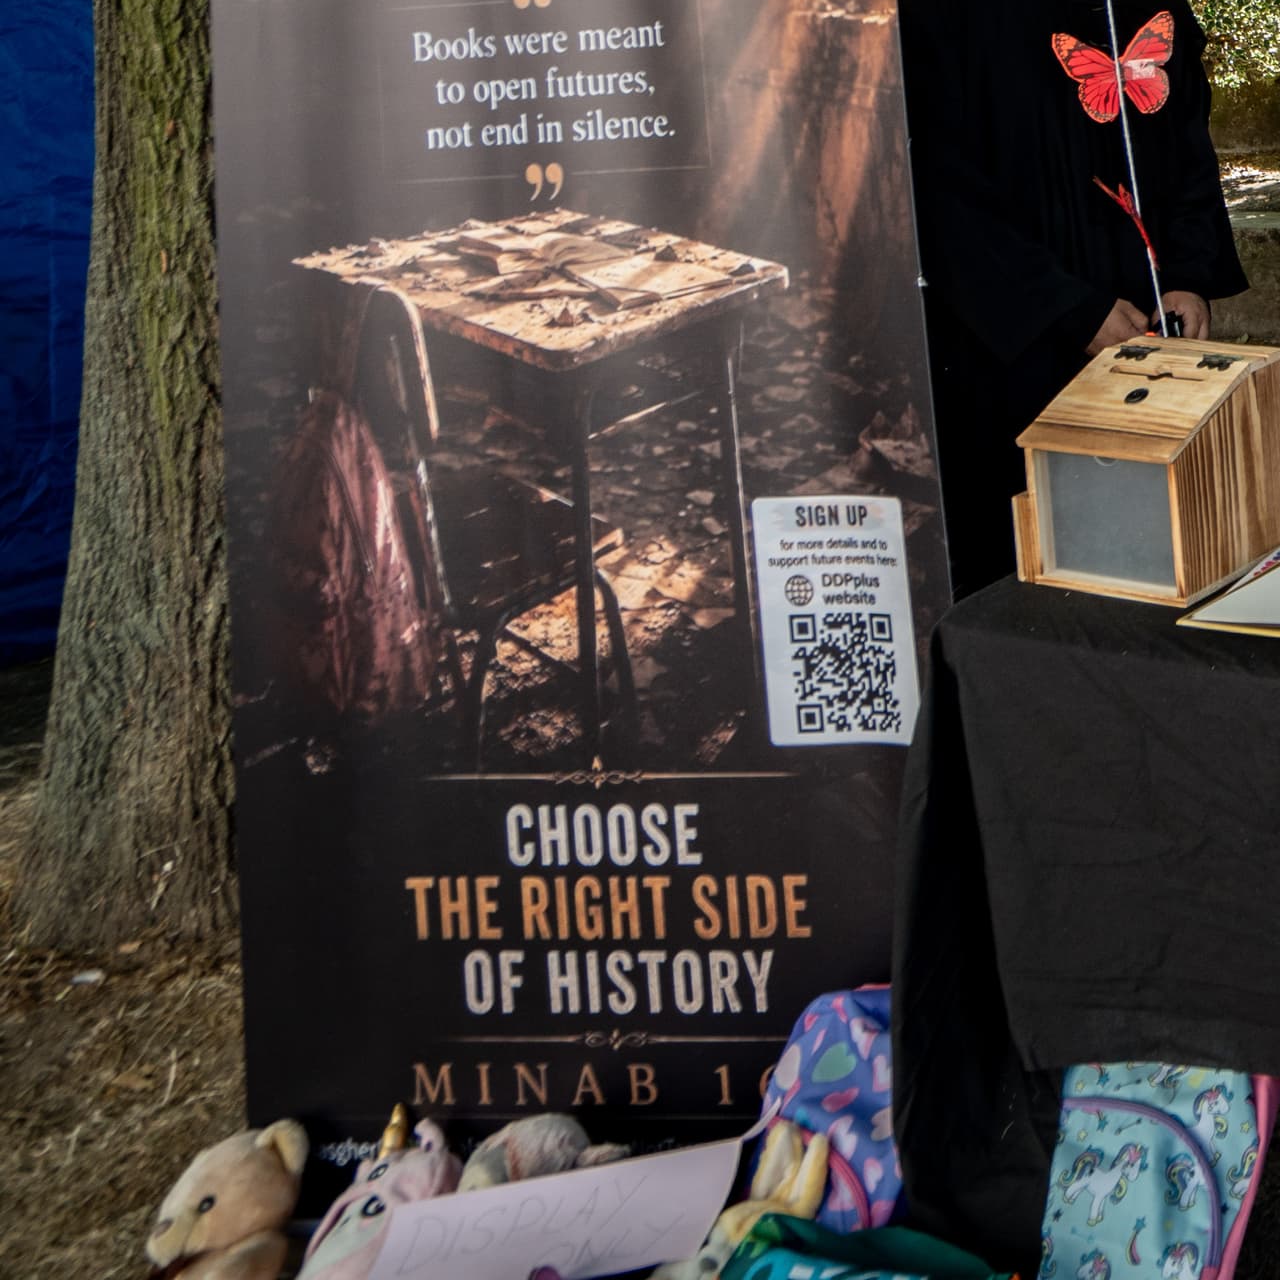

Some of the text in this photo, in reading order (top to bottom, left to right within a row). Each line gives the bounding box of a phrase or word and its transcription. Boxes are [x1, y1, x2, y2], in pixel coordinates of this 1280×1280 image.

[412, 20, 665, 62] Books were meant
[436, 66, 655, 110] to open futures,
[427, 109, 676, 150] not end in silence.
[795, 505, 868, 527] SIGN UP
[768, 555, 809, 568] support
[811, 554, 843, 566] future
[845, 555, 875, 565] events
[780, 538, 888, 551] for more details and to
[822, 573, 880, 590] DDPplus
[823, 592, 876, 605] website
[505, 802, 703, 867] CHOOSE
[405, 873, 812, 941] THE RIGHT SIDE
[463, 948, 775, 1016] OF HISTORY
[412, 1062, 659, 1106] MINAB
